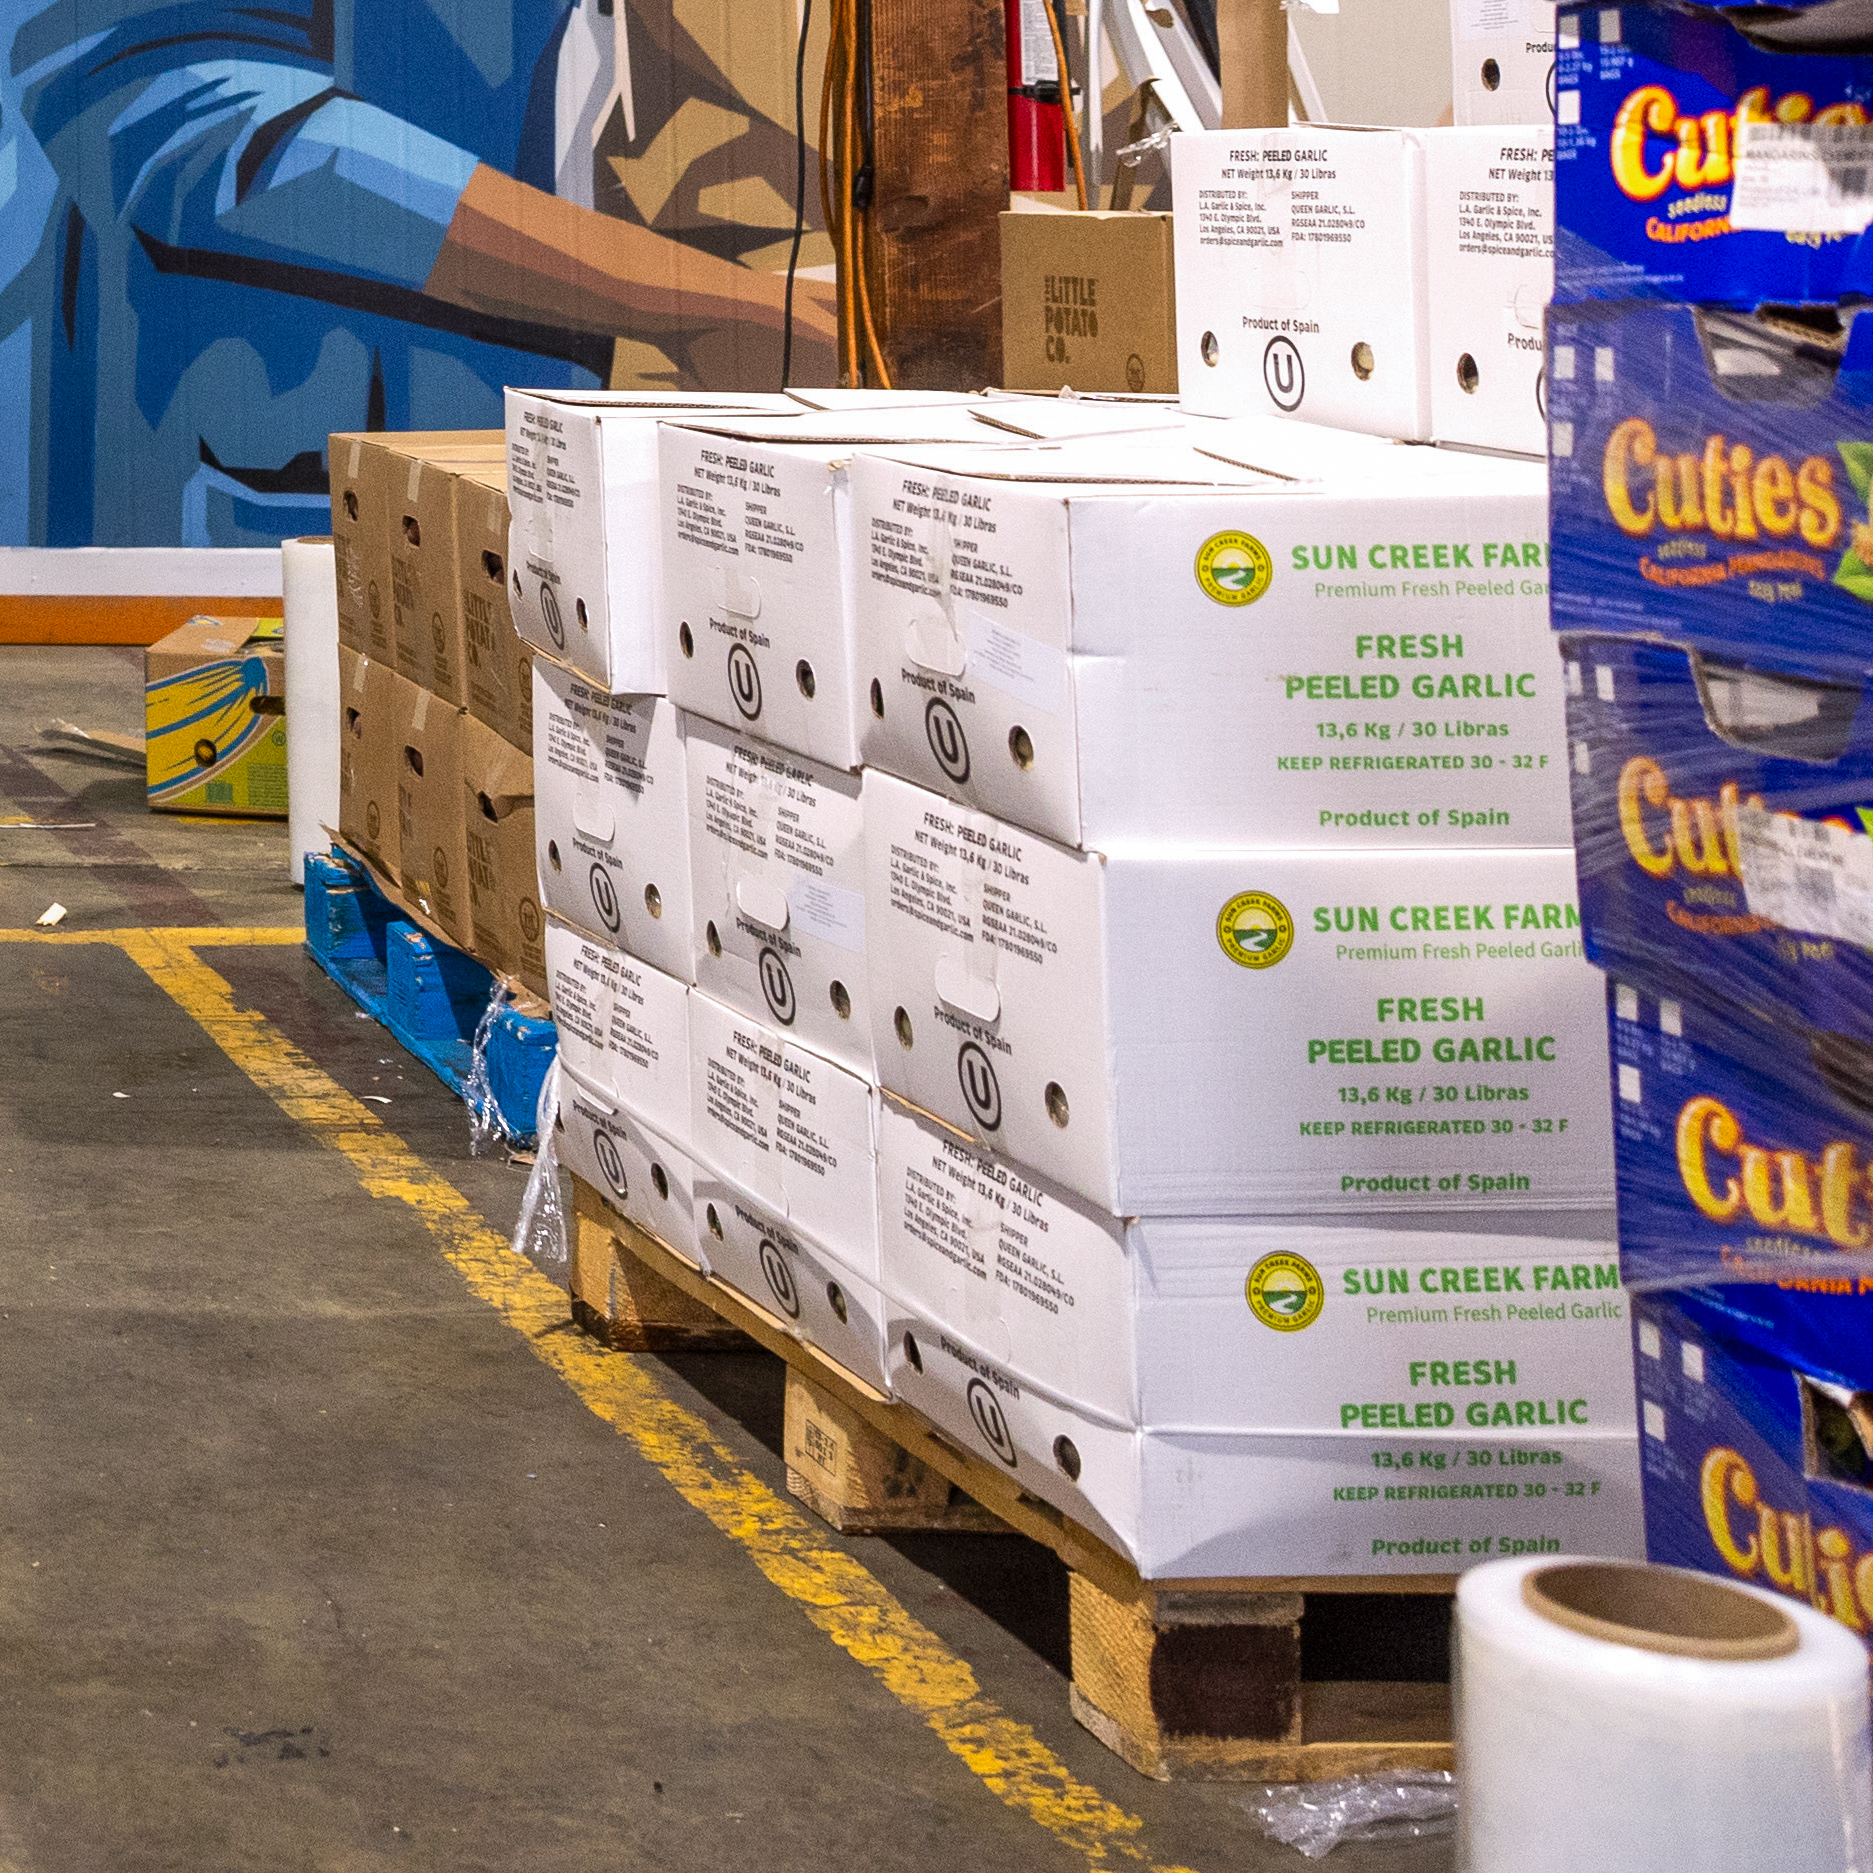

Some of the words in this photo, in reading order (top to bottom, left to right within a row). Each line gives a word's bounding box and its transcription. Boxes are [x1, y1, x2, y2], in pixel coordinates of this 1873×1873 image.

[1230, 150, 1259, 162] FRESH:
[1263, 150, 1291, 161] PEELED
[1294, 150, 1328, 162] GARLIC
[1221, 169, 1235, 178] NET
[1237, 169, 1263, 180] Weight
[1283, 169, 1292, 181] Kg
[1300, 169, 1309, 179] 30
[1311, 169, 1336, 179] Libras
[1242, 316, 1279, 331] Product
[1281, 319, 1291, 331] of
[1293, 319, 1319, 334] Spain
[1603, 417, 1842, 548] Cuties
[1291, 544, 1357, 570] SUN
[1368, 544, 1471, 569] CREEK
[1482, 542, 1549, 568] FAR
[1315, 582, 1396, 598] Premium
[1402, 581, 1450, 597] Fresh
[1455, 580, 1515, 596] Peeled
[1521, 580, 1549, 595] Gar
[1355, 634, 1464, 659] FRESH
[1285, 674, 1400, 700] PEELED
[1412, 673, 1536, 698] GARLIC
[1316, 722, 1358, 740] 13,6
[1364, 722, 1392, 740] Kg
[1411, 721, 1437, 738] 30
[1444, 721, 1509, 738] Libras
[1277, 756, 1323, 771] KEEP
[1329, 755, 1465, 771] REFRIGERATED
[1470, 754, 1493, 770] 30
[1512, 754, 1535, 769] 32
[1539, 754, 1549, 769] F
[1319, 809, 1410, 827] Product
[1417, 808, 1439, 826] of
[1447, 808, 1510, 829] Spain
[1313, 906, 1379, 933] SUN
[1389, 905, 1492, 931] CREEK
[1336, 944, 1416, 961] Premium
[1423, 944, 1471, 960] Fresh
[1475, 943, 1535, 959] Peeled
[1541, 942, 1582, 958] Garli
[1377, 997, 1485, 1022] FRESH
[1307, 1038, 1422, 1064] PEELED
[1432, 1037, 1557, 1062] GARLIC
[1337, 1086, 1380, 1105] 13,6
[1385, 1086, 1412, 1105] Kg
[1432, 1086, 1459, 1102] 30
[1465, 1085, 1529, 1102] Libras
[1341, 1175, 1431, 1192] Product
[1438, 1174, 1461, 1191] of
[1468, 1173, 1530, 1194] Spain
[1343, 1268, 1409, 1295] SUN
[1419, 1266, 1522, 1293] CREEK
[1533, 1264, 1620, 1291] FARM
[1367, 1306, 1448, 1324] Premium
[1454, 1305, 1502, 1322] Fresh
[1507, 1303, 1566, 1321] Peeled
[1571, 1301, 1623, 1320] Garlic
[1409, 1360, 1517, 1386] FRESH
[1340, 1402, 1454, 1429] PEELED
[1465, 1399, 1589, 1427] GARLIC
[1371, 1537, 1462, 1556] Product
[1469, 1536, 1492, 1554] of
[1497, 1535, 1561, 1556] Spain
